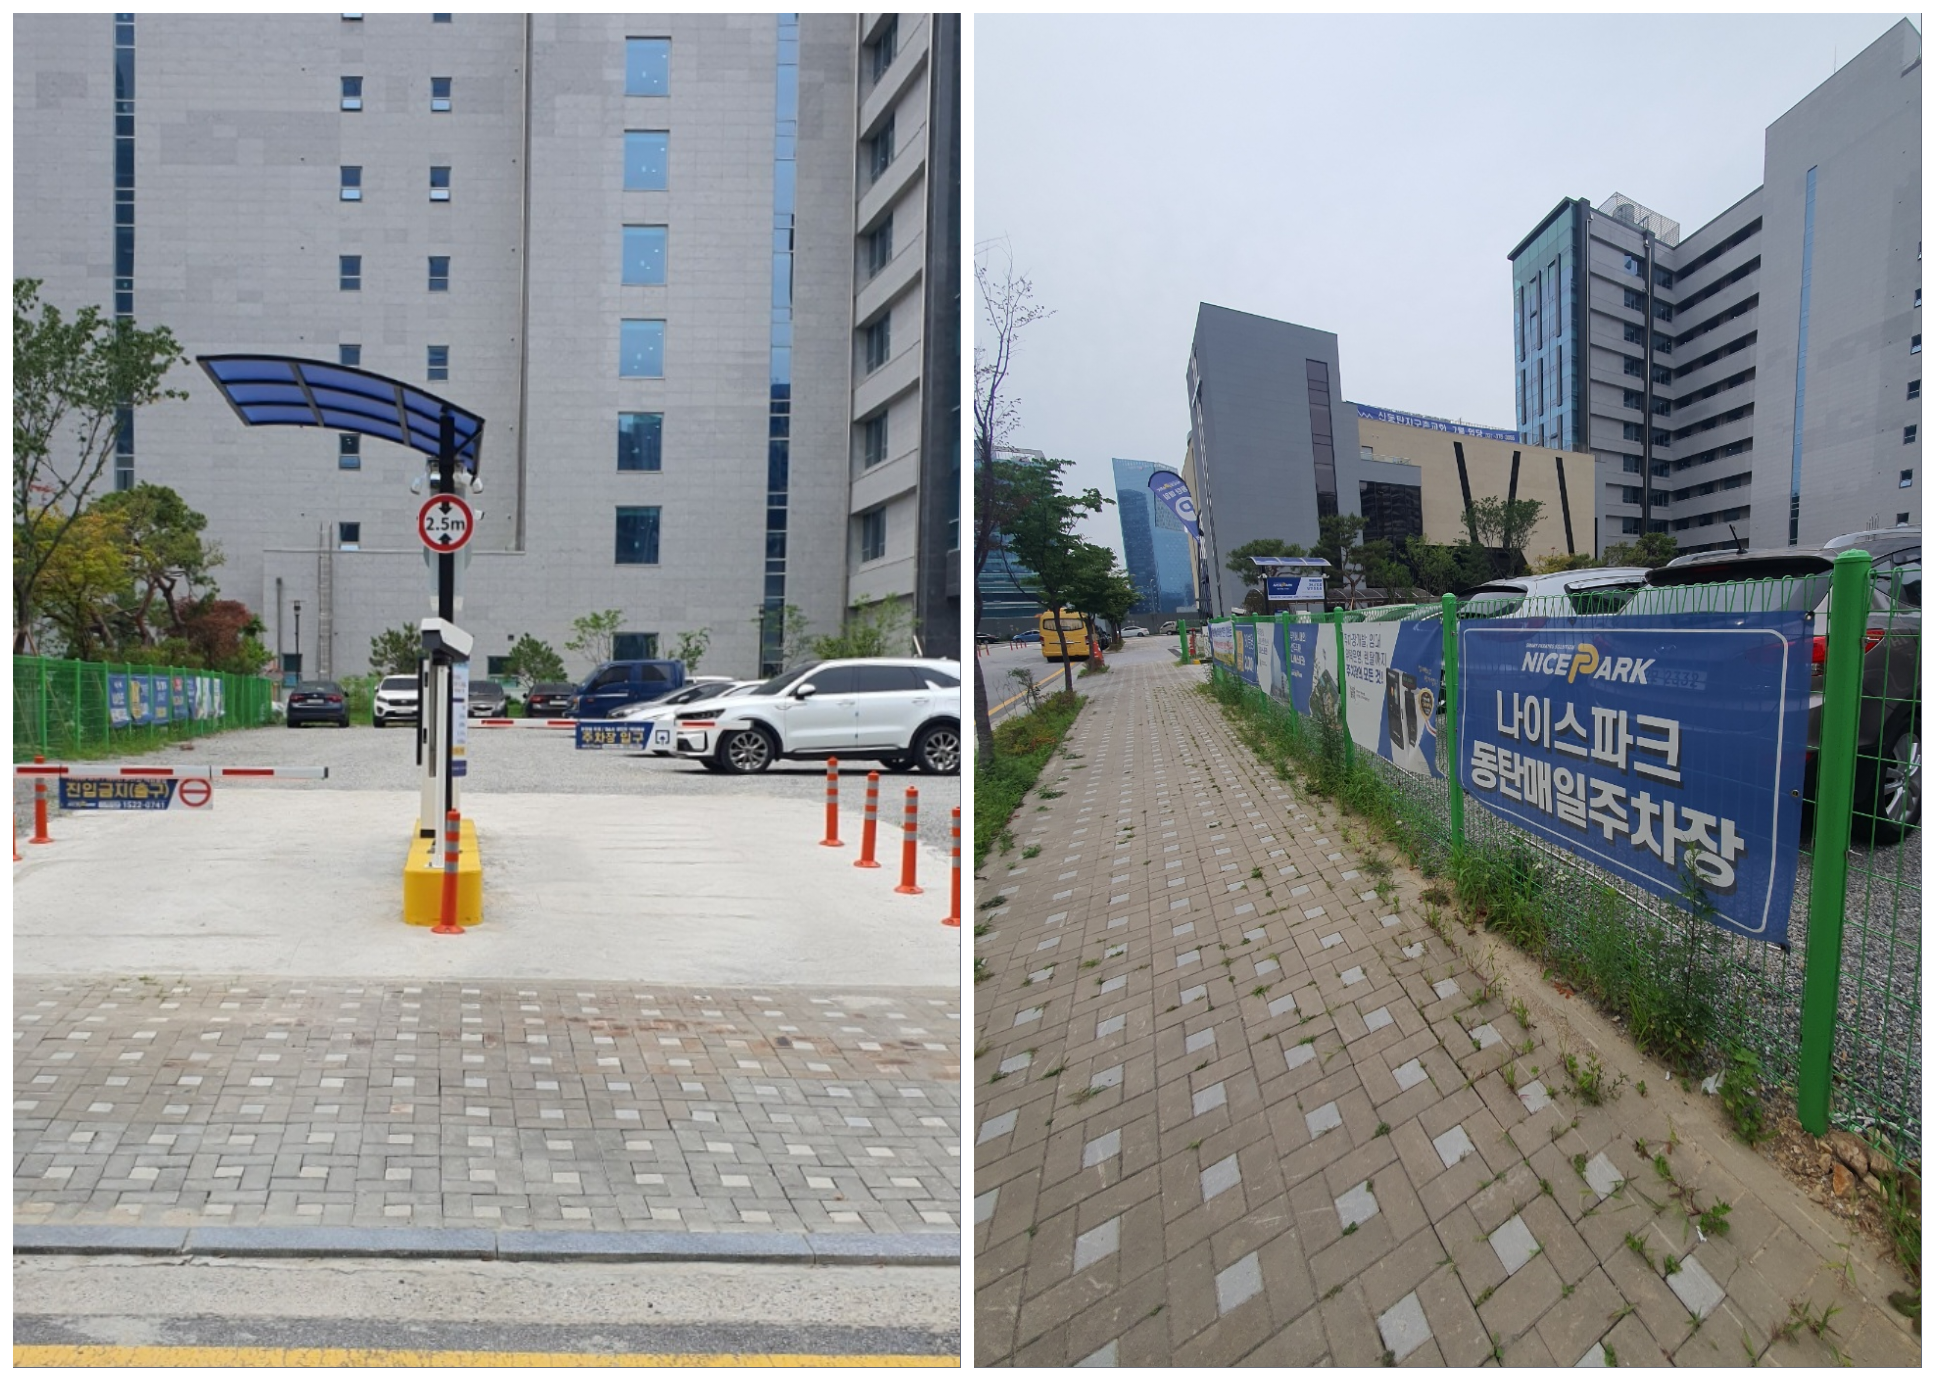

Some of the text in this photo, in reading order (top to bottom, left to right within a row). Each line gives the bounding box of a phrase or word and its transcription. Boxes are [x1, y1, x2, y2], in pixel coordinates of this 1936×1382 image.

[425, 517, 465, 531] 2.5m
[1521, 643, 1656, 685] NICEPARK
[582, 731, 644, 744] 주차장 입구
[1496, 689, 1682, 782] 나이스파크
[66, 782, 170, 799] 진입금지(출구)
[1470, 740, 1745, 888] 동탄매일주차장
